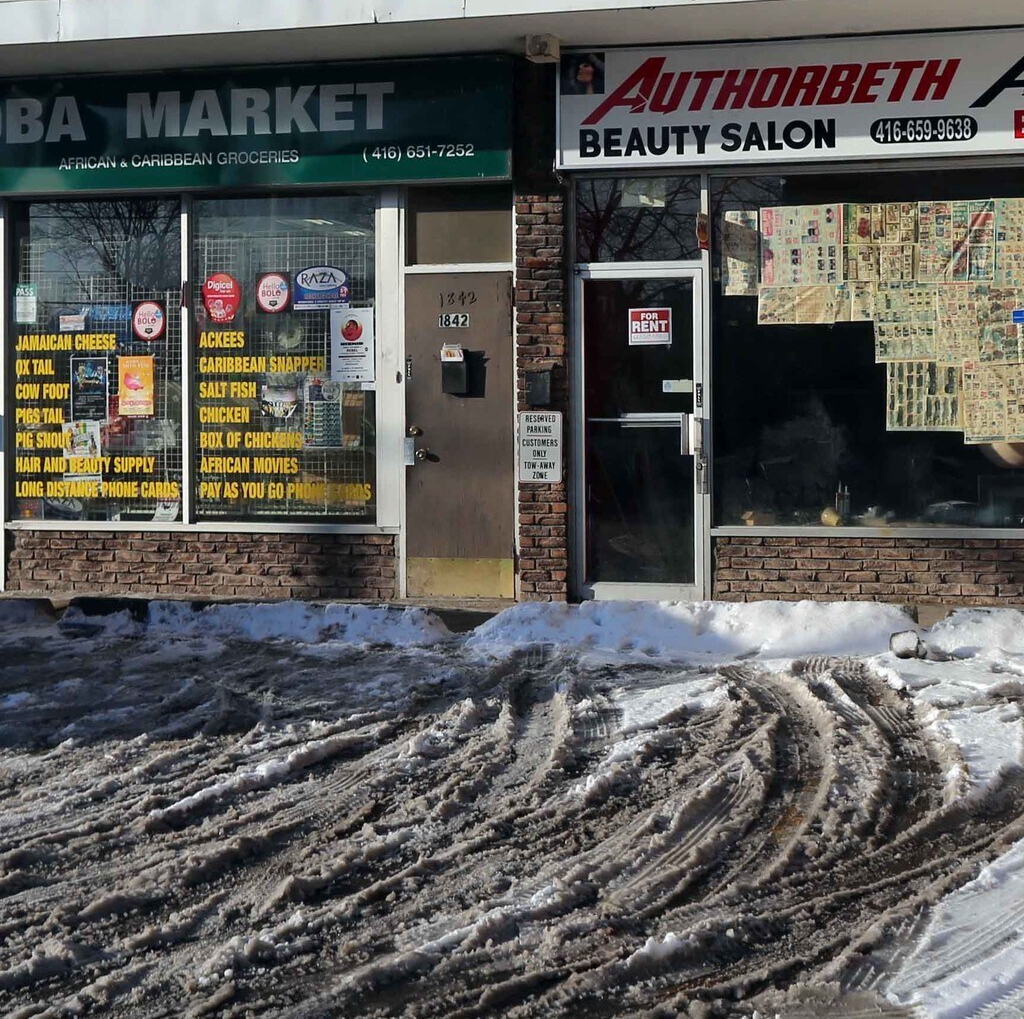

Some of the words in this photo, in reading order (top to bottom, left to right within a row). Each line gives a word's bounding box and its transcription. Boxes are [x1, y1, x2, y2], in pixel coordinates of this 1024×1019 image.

[580, 57, 962, 126] AUTHORBETH
[0, 96, 87, 144] BA
[126, 82, 395, 139] MARKET
[875, 118, 972, 143] 416-659-9638
[579, 124, 711, 159] BEAUTY
[720, 119, 836, 152] SALON
[59, 154, 116, 170] AFRICAN
[120, 158, 128, 168] &
[131, 152, 213, 168] CARIBBEAN
[217, 149, 299, 165] GROCERIES
[406, 144, 475, 159] 651-7252
[16, 288, 34, 296] PASS
[207, 281, 233, 293] Digicel
[439, 315, 468, 327] 1842
[640, 313, 658, 321] FOR
[632, 321, 668, 332] RENT
[15, 334, 72, 351] JAMAICAN
[75, 334, 116, 350] CHEESE
[200, 331, 245, 348] ACKEES
[16, 359, 30, 375] OX
[32, 359, 54, 375] TAIL
[200, 356, 266, 373] CARIBBEAN
[269, 356, 325, 373] SNAPPER
[15, 383, 40, 400] COW
[43, 383, 70, 399] FOOT
[200, 382, 227, 398] SALT
[231, 382, 256, 398] FISH
[15, 408, 40, 424] PIGS
[42, 408, 65, 424] TAIL
[200, 407, 250, 423] CHICKEN
[15, 432, 33, 448] PIG
[200, 432, 223, 448] BOX
[227, 432, 241, 448] OF
[522, 439, 558, 447] CUSTOMERS
[16, 457, 41, 473] HAIR
[43, 457, 66, 473] AND
[70, 457, 110, 473] BEAUTY
[114, 457, 155, 473] SUPPLY
[200, 457, 250, 473] AFRICAN
[253, 457, 298, 474] MOVIES
[524, 462, 555, 470] TOW-AWAY
[16, 482, 44, 498] LONG
[47, 482, 98, 498] DISTANCE
[102, 482, 139, 498] PHONE
[141, 482, 179, 498] CARDS
[200, 482, 221, 499] PAY
[224, 482, 238, 499] AS
[242, 482, 264, 499] YOU
[268, 482, 284, 499] GO
